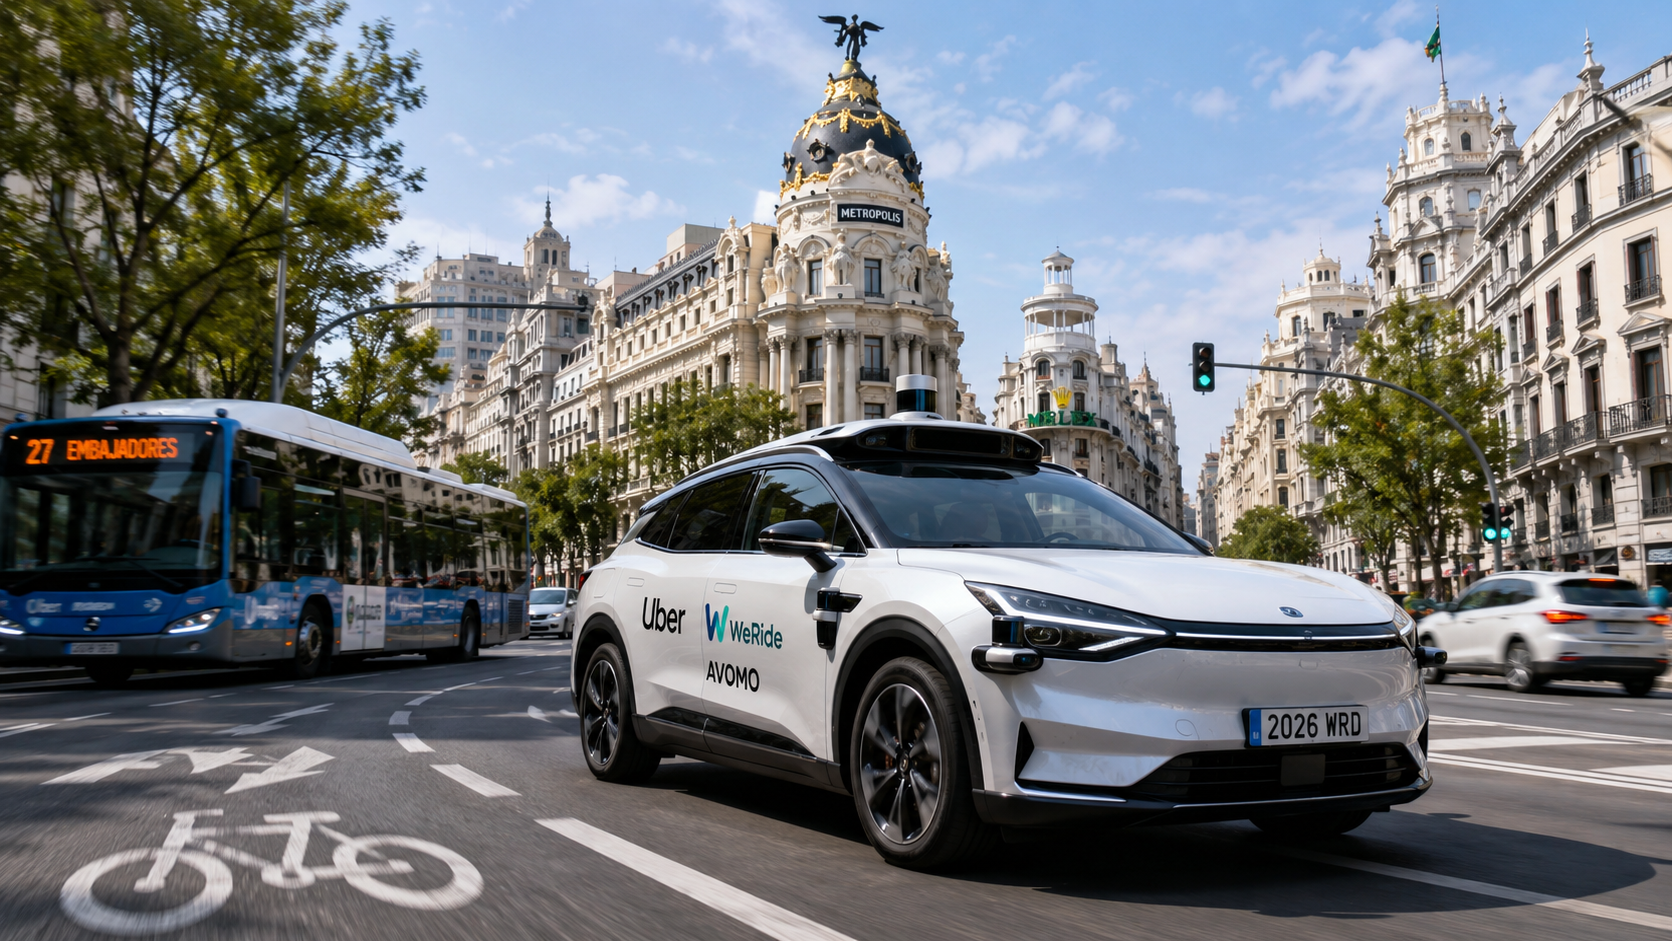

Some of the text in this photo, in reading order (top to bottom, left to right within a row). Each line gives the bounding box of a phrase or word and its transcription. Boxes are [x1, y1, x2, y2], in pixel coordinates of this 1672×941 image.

[841, 208, 901, 223] METROPOLIS
[25, 437, 179, 465] 27 EMBAJADORES
[642, 597, 686, 634] Uber
[730, 620, 783, 649] WeRide
[706, 660, 760, 693] AVOMO
[1267, 711, 1361, 740] 2026 WRD
